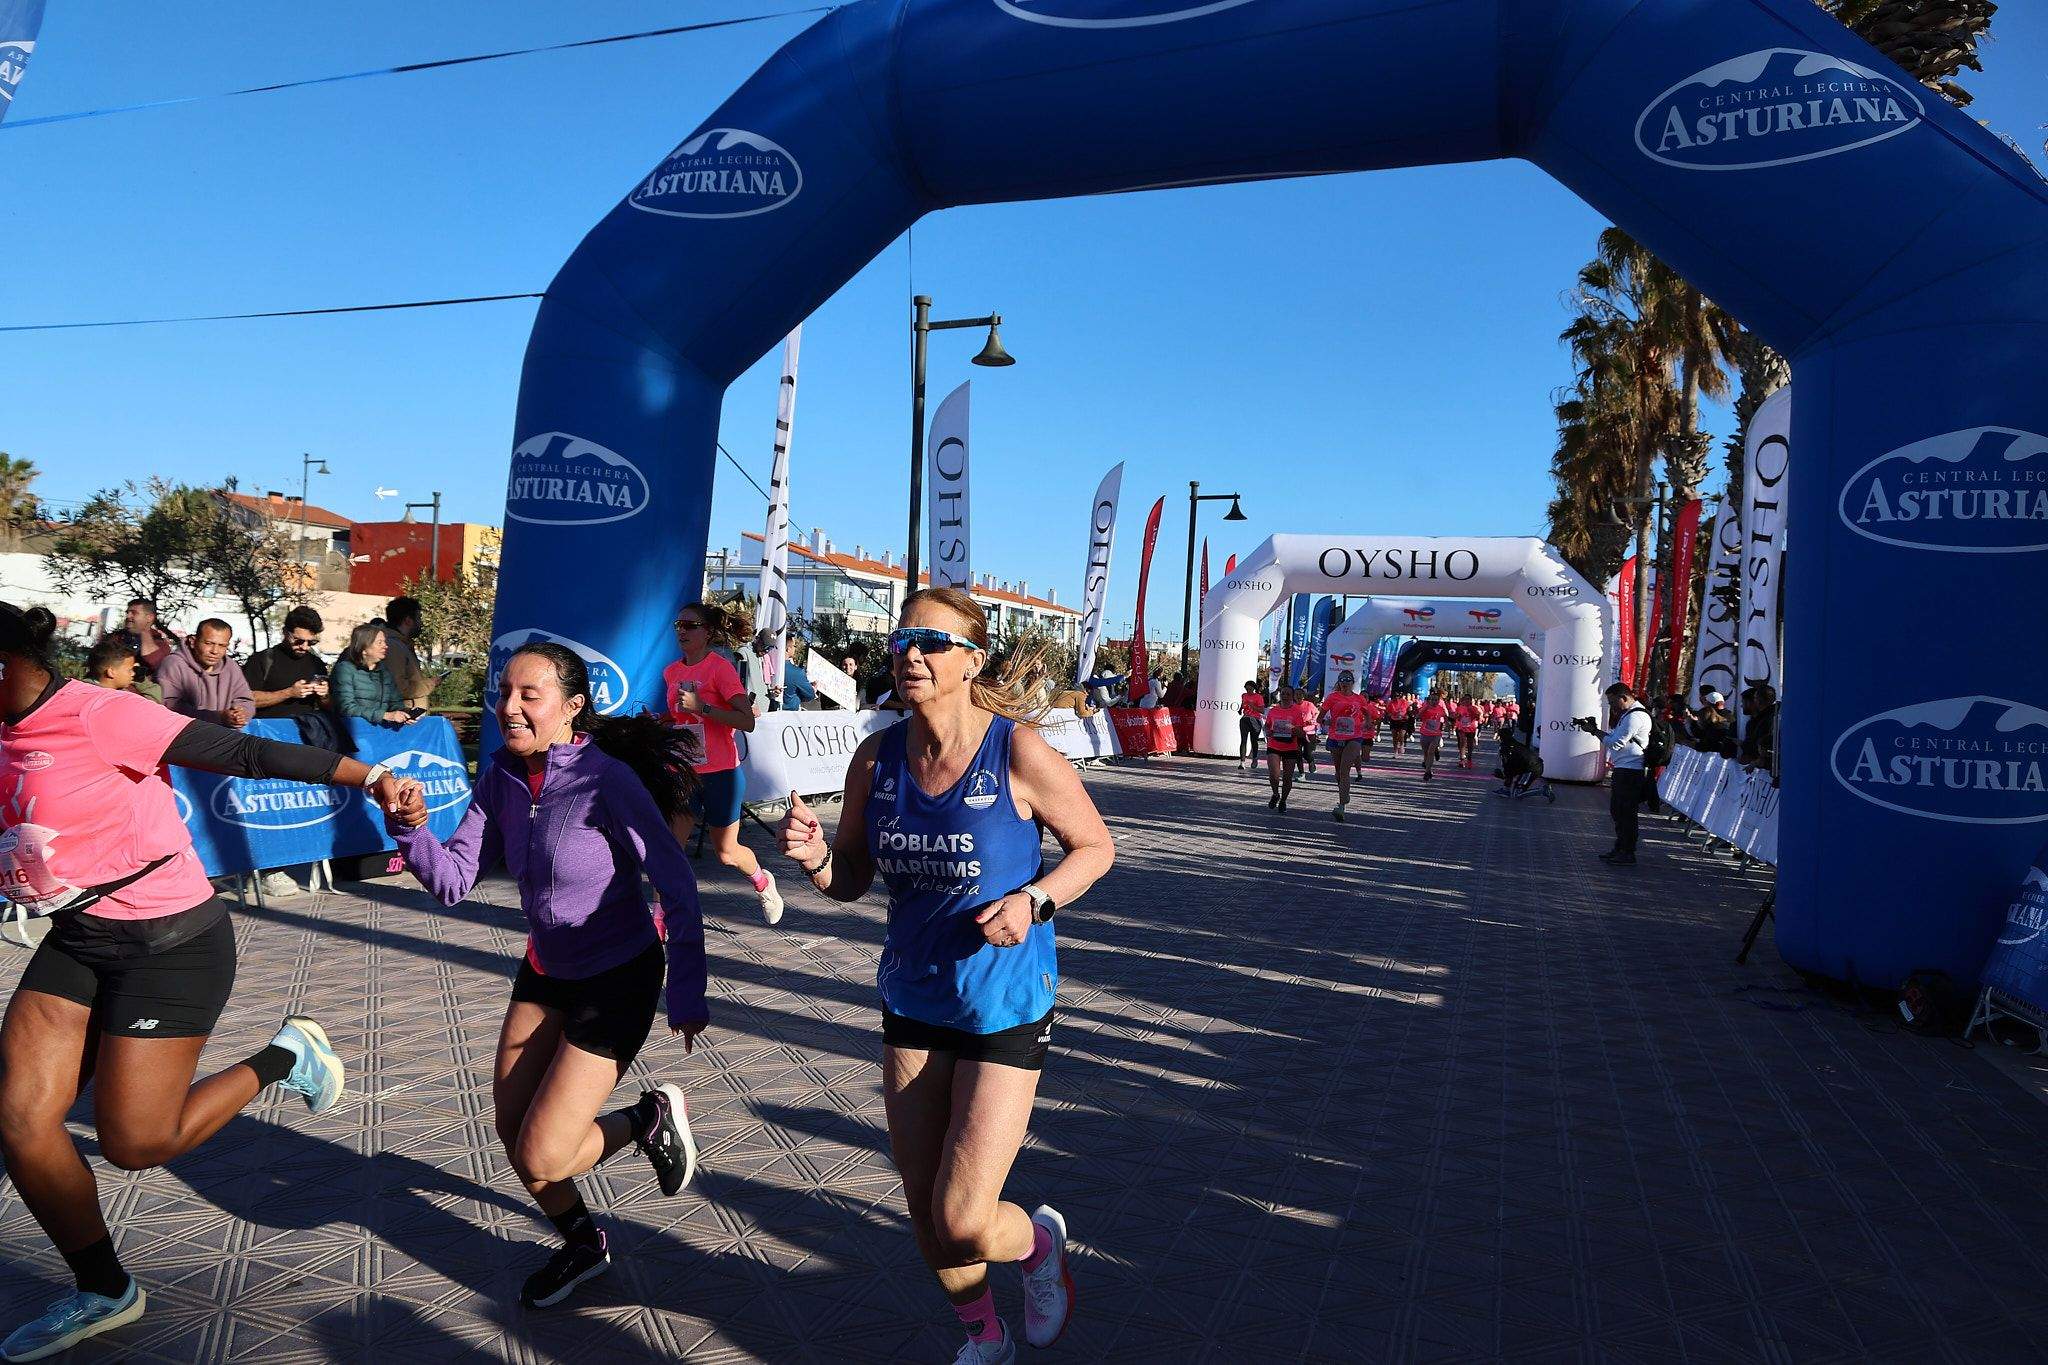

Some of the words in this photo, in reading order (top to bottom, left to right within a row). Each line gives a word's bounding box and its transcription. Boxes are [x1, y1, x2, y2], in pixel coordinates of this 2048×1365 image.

[1699, 85, 1794, 109] CENTRAL
[1803, 82, 1892, 95] LECHERA
[1656, 97, 1908, 152] ASTURIANA
[665, 157, 714, 173] CENTRAL
[719, 154, 781, 166] LECHERA
[634, 169, 787, 200] ASTURIANA
[565, 465, 630, 480] LECHERA
[1902, 470, 2002, 484] CENTRAL
[936, 436, 967, 590] YSHO
[1318, 547, 1480, 580] OYSHO
[1227, 580, 1272, 592] OYSHO
[1527, 585, 1579, 597] OYSHO
[1204, 638, 1245, 650] OYSHO
[1433, 648, 1501, 657] VOLVO
[1553, 654, 1602, 666] OYSHO
[1200, 699, 1240, 711] OYSHO
[781, 723, 859, 759] OYSHO
[1894, 736, 1993, 752] CENTRAL
[223, 787, 342, 815] ASTURIANA
[879, 831, 975, 852] POBLATS
[876, 855, 981, 877] MARÍTIMS
